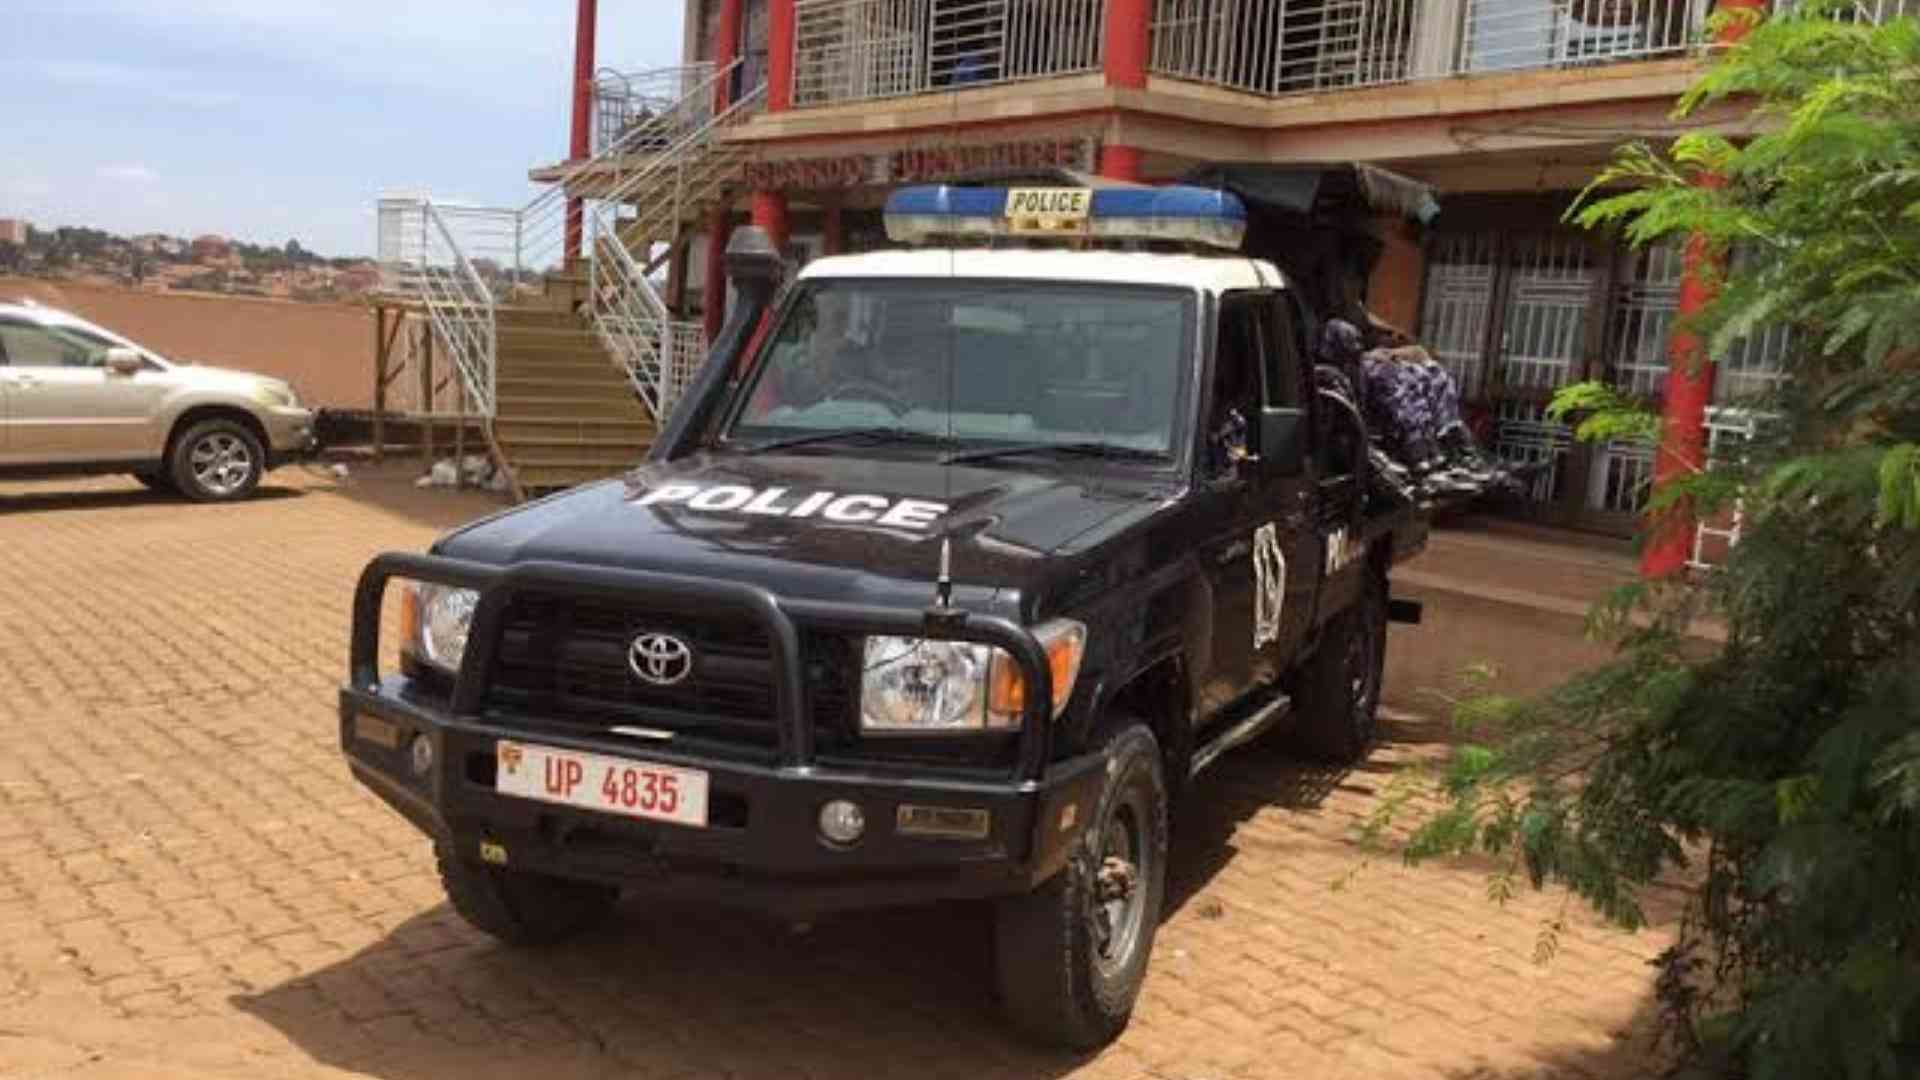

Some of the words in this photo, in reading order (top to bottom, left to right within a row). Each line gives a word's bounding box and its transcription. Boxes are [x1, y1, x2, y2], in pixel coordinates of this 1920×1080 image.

[1014, 192, 1082, 212] POLICE
[633, 485, 950, 528] POLICE
[545, 756, 583, 798] UP
[602, 765, 680, 814] 4835
